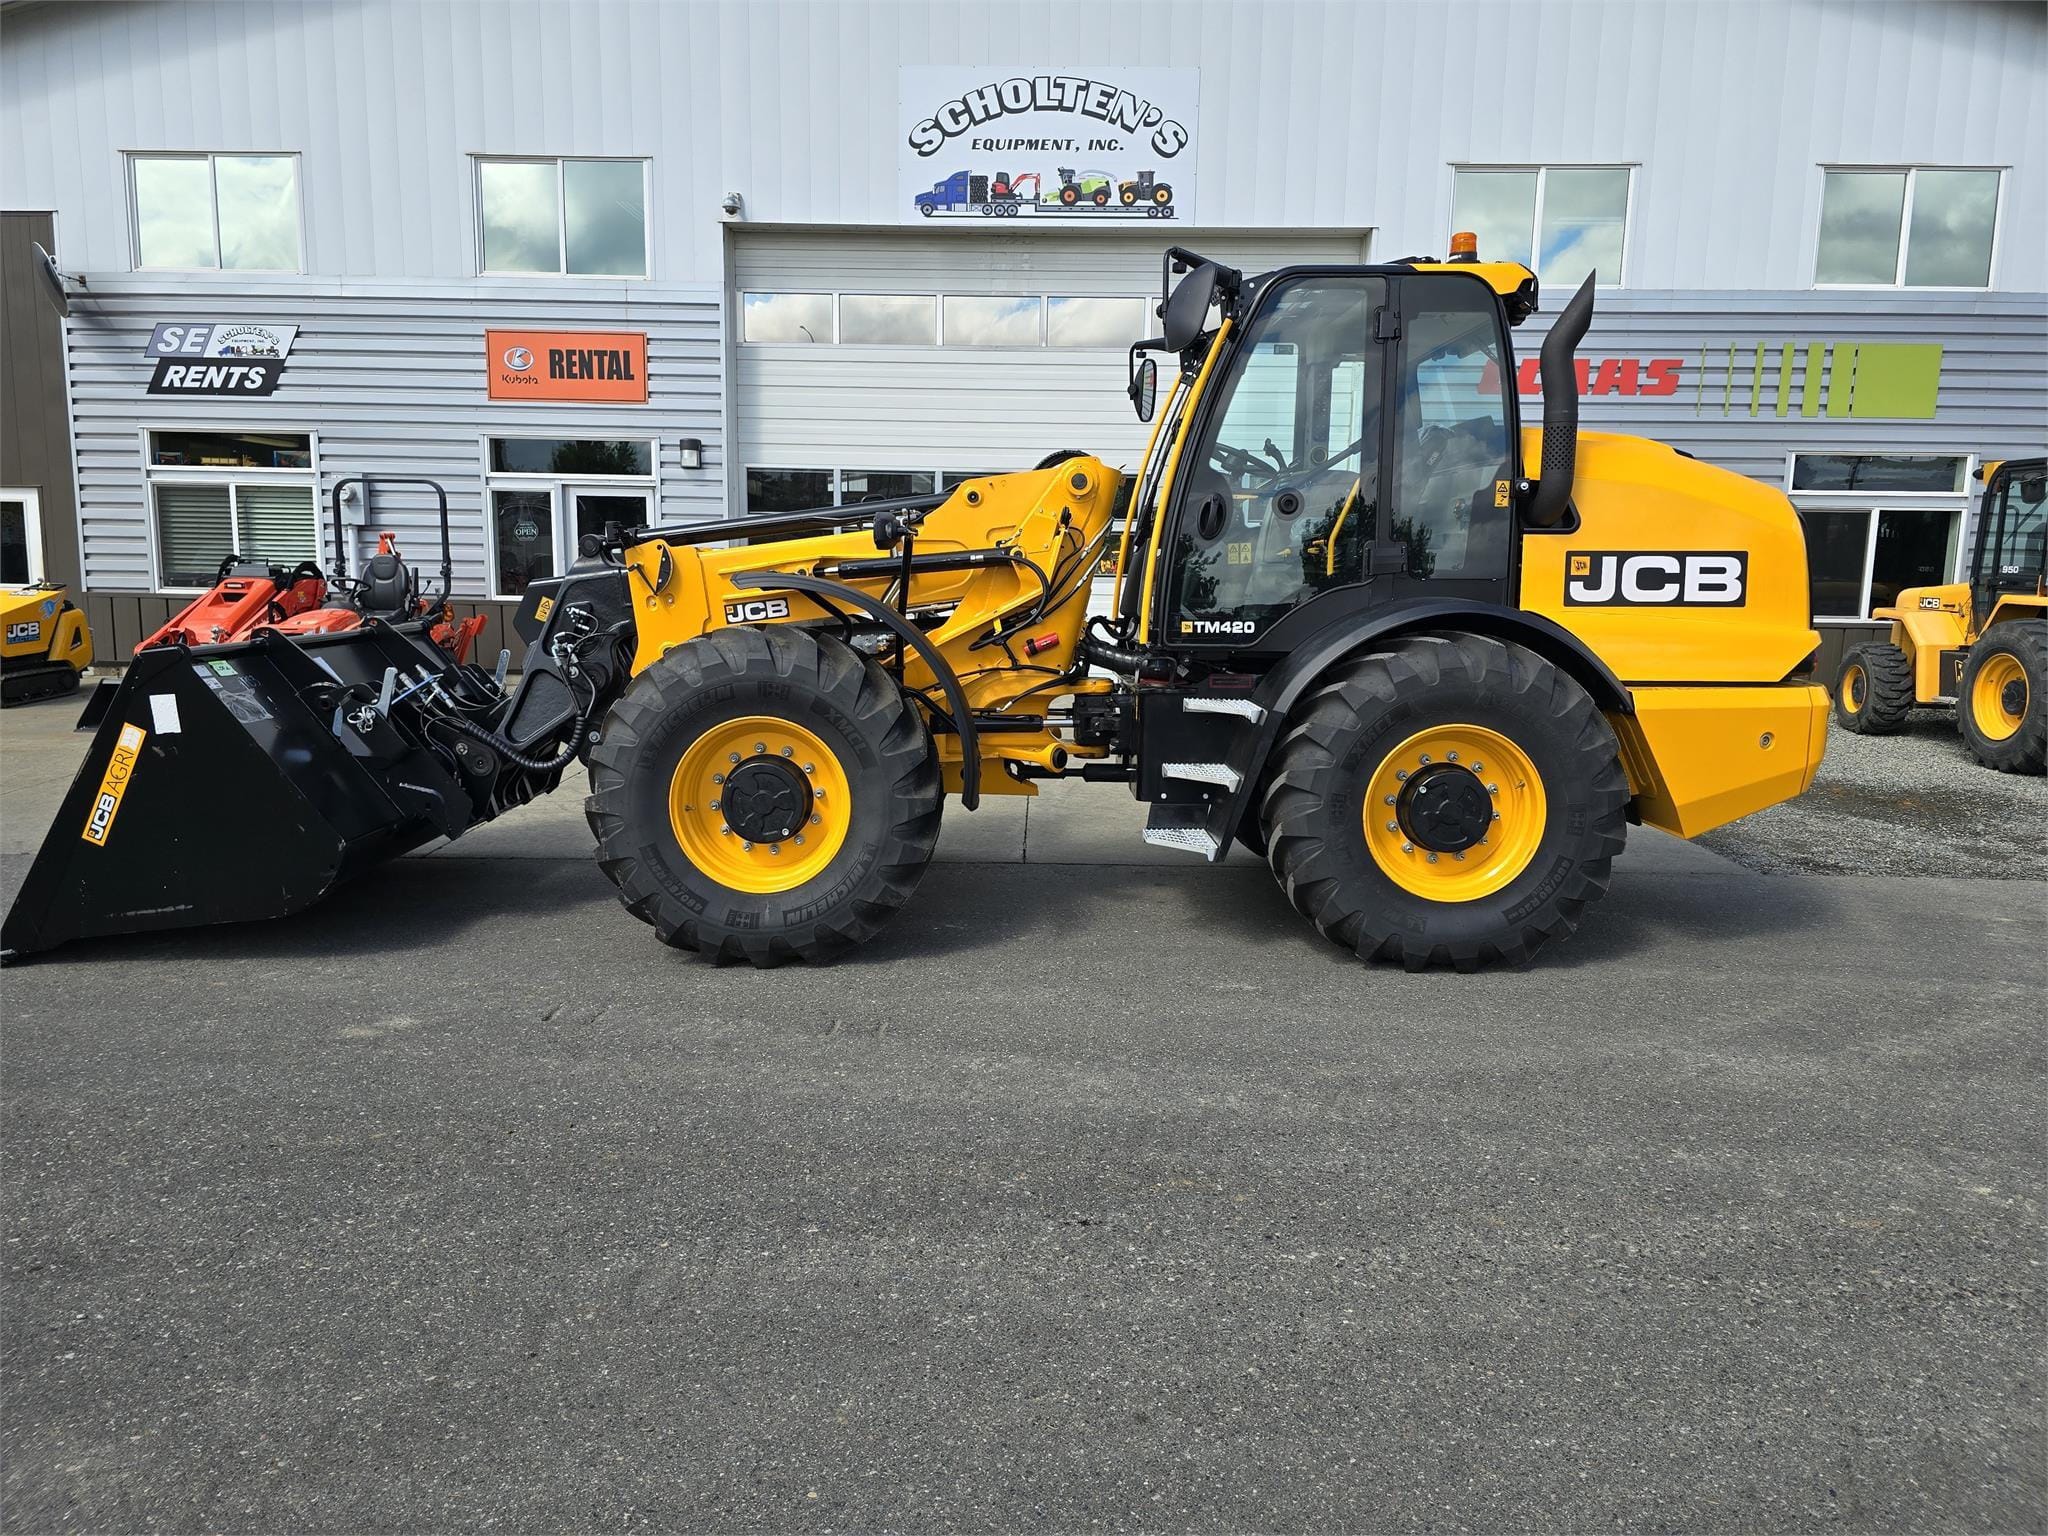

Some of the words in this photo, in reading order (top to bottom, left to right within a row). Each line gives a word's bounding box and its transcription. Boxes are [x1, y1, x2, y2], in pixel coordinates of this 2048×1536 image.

[908, 76, 1189, 158] SCHOLTEN'S
[971, 138, 1080, 153] EQUIPMENT,
[1087, 138, 1125, 151] INC.
[157, 327, 210, 353] SE
[549, 349, 635, 380] RENTAL
[161, 365, 267, 389] RENTS
[502, 374, 539, 384] Kubota
[1569, 556, 1742, 603] JCB
[2002, 565, 2019, 574] 950
[727, 599, 788, 623] JCB
[1920, 598, 1940, 608] JCB
[7, 622, 40, 637] JCB
[1194, 621, 1255, 634] TM420
[90, 794, 116, 840] JCB
[106, 747, 135, 795] AGRI
[783, 863, 868, 925] MICHELIN
